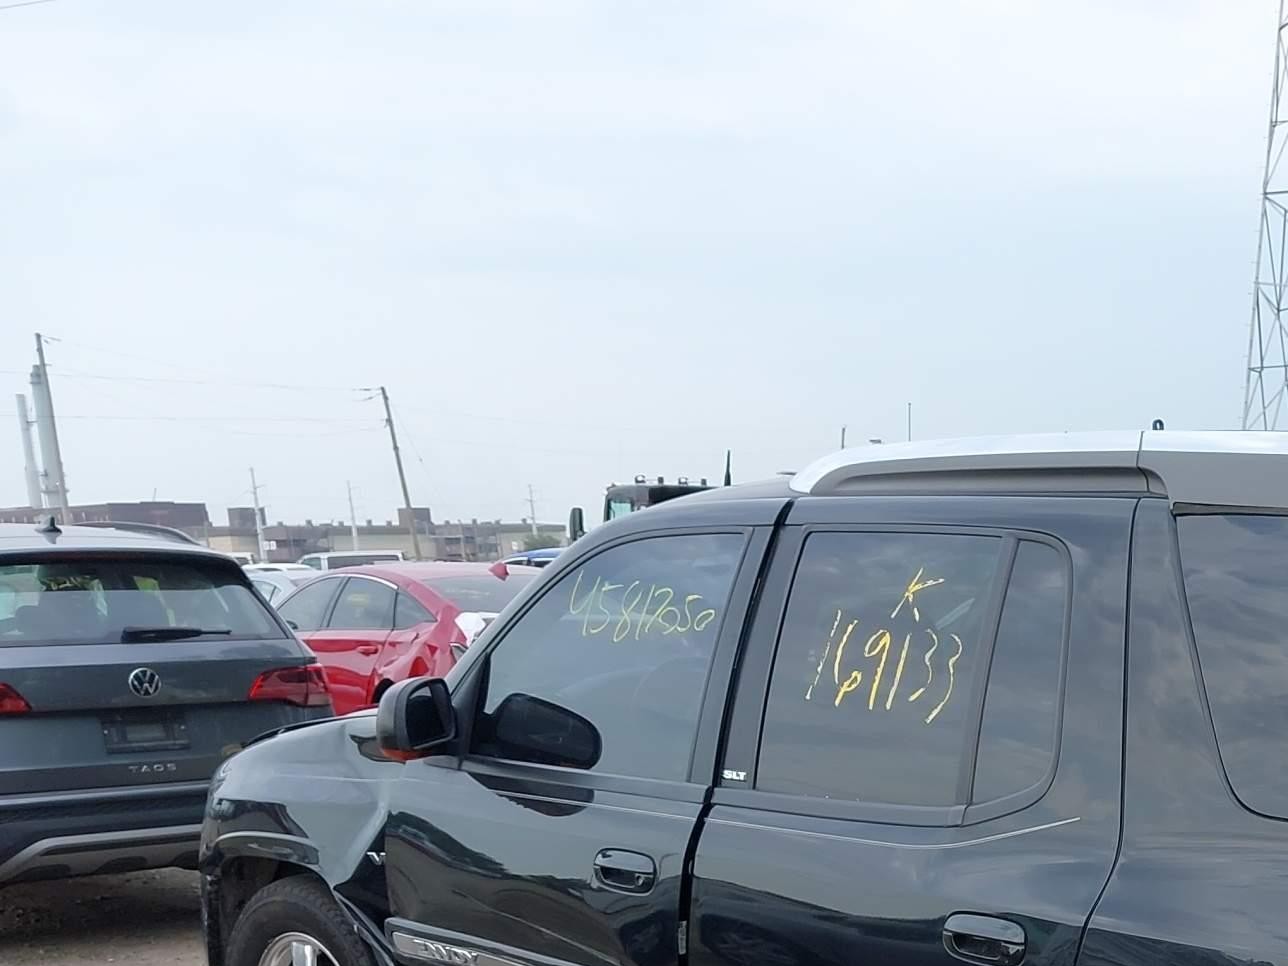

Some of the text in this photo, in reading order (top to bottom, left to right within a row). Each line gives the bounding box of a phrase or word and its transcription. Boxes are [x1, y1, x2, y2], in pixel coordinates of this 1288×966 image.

[891, 567, 945, 622] K
[128, 763, 177, 773] TAOS
[723, 769, 747, 780] SLT
